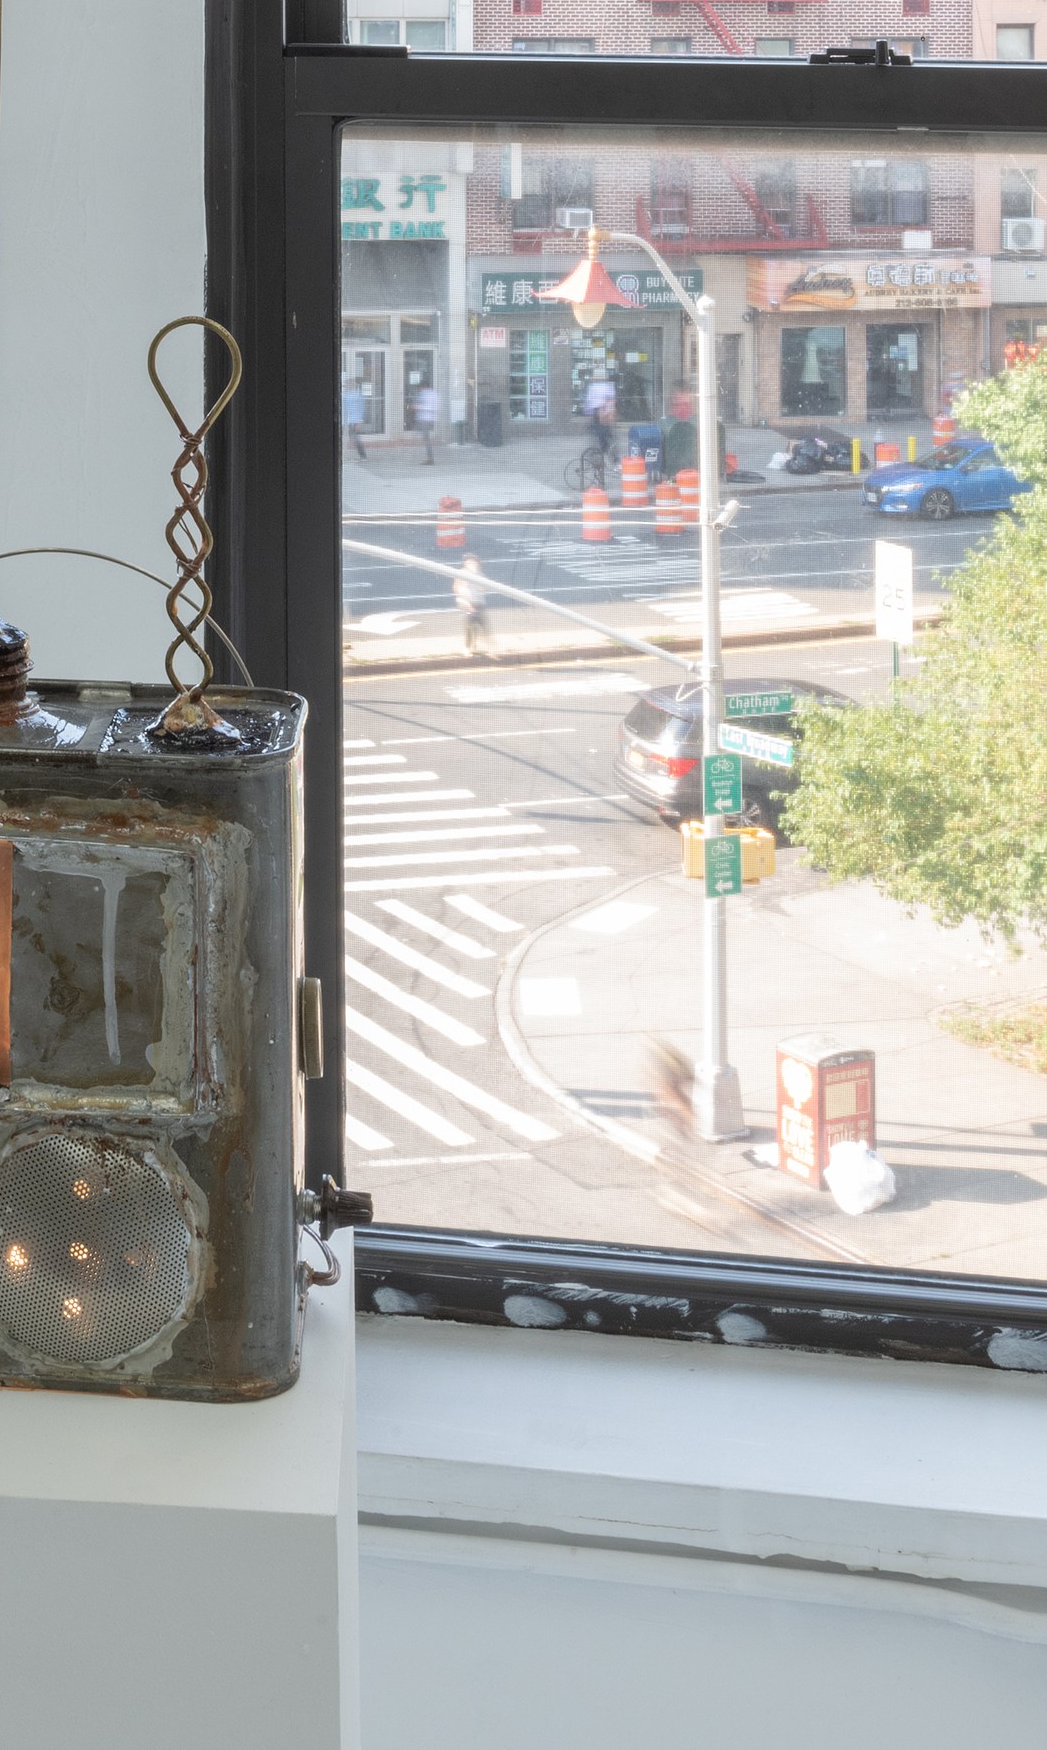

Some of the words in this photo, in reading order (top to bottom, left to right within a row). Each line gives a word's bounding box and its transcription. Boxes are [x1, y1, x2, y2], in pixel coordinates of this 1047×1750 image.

[342, 221, 383, 239] ENT
[389, 220, 446, 239] BANK
[642, 291, 700, 303] PHARMCY
[482, 329, 504, 339] ATM
[882, 583, 904, 611] 25
[729, 696, 780, 709] Chatham
